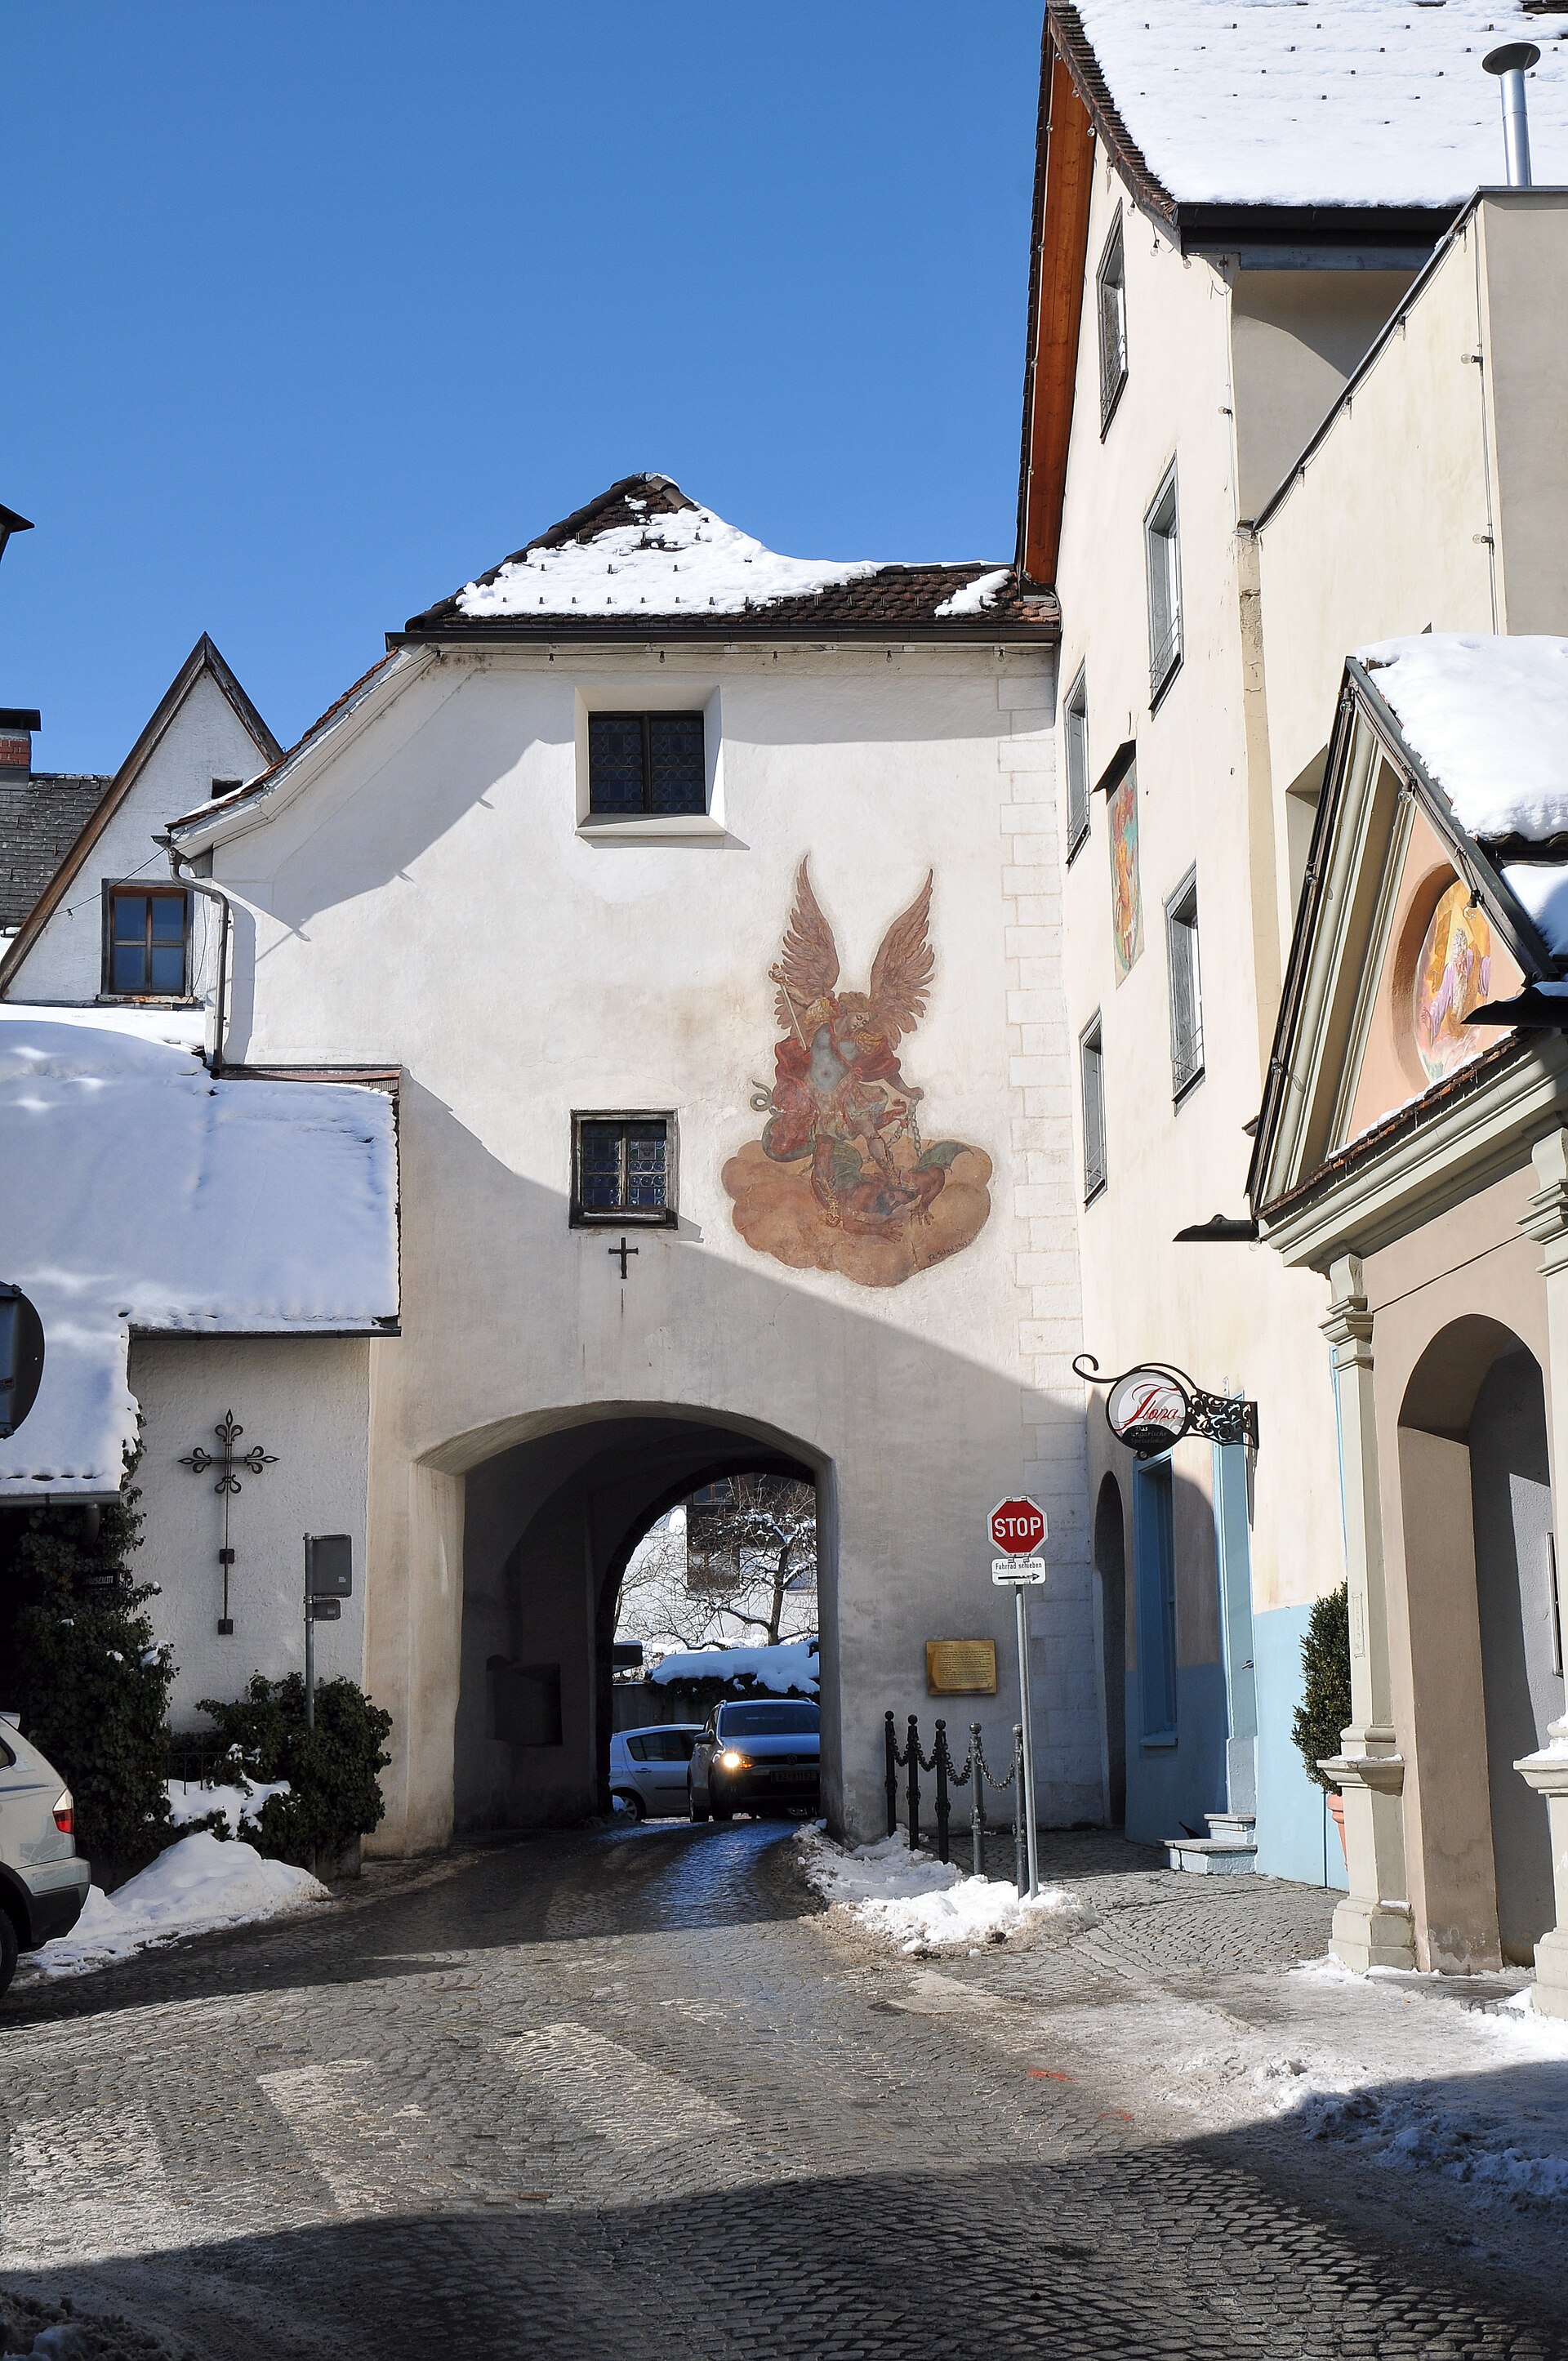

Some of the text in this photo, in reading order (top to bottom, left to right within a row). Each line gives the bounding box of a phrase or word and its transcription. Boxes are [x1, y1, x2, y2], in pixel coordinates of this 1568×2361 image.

[994, 1517, 1041, 1538] STOP
[995, 1561, 1042, 1570] Fahrrad schieben
